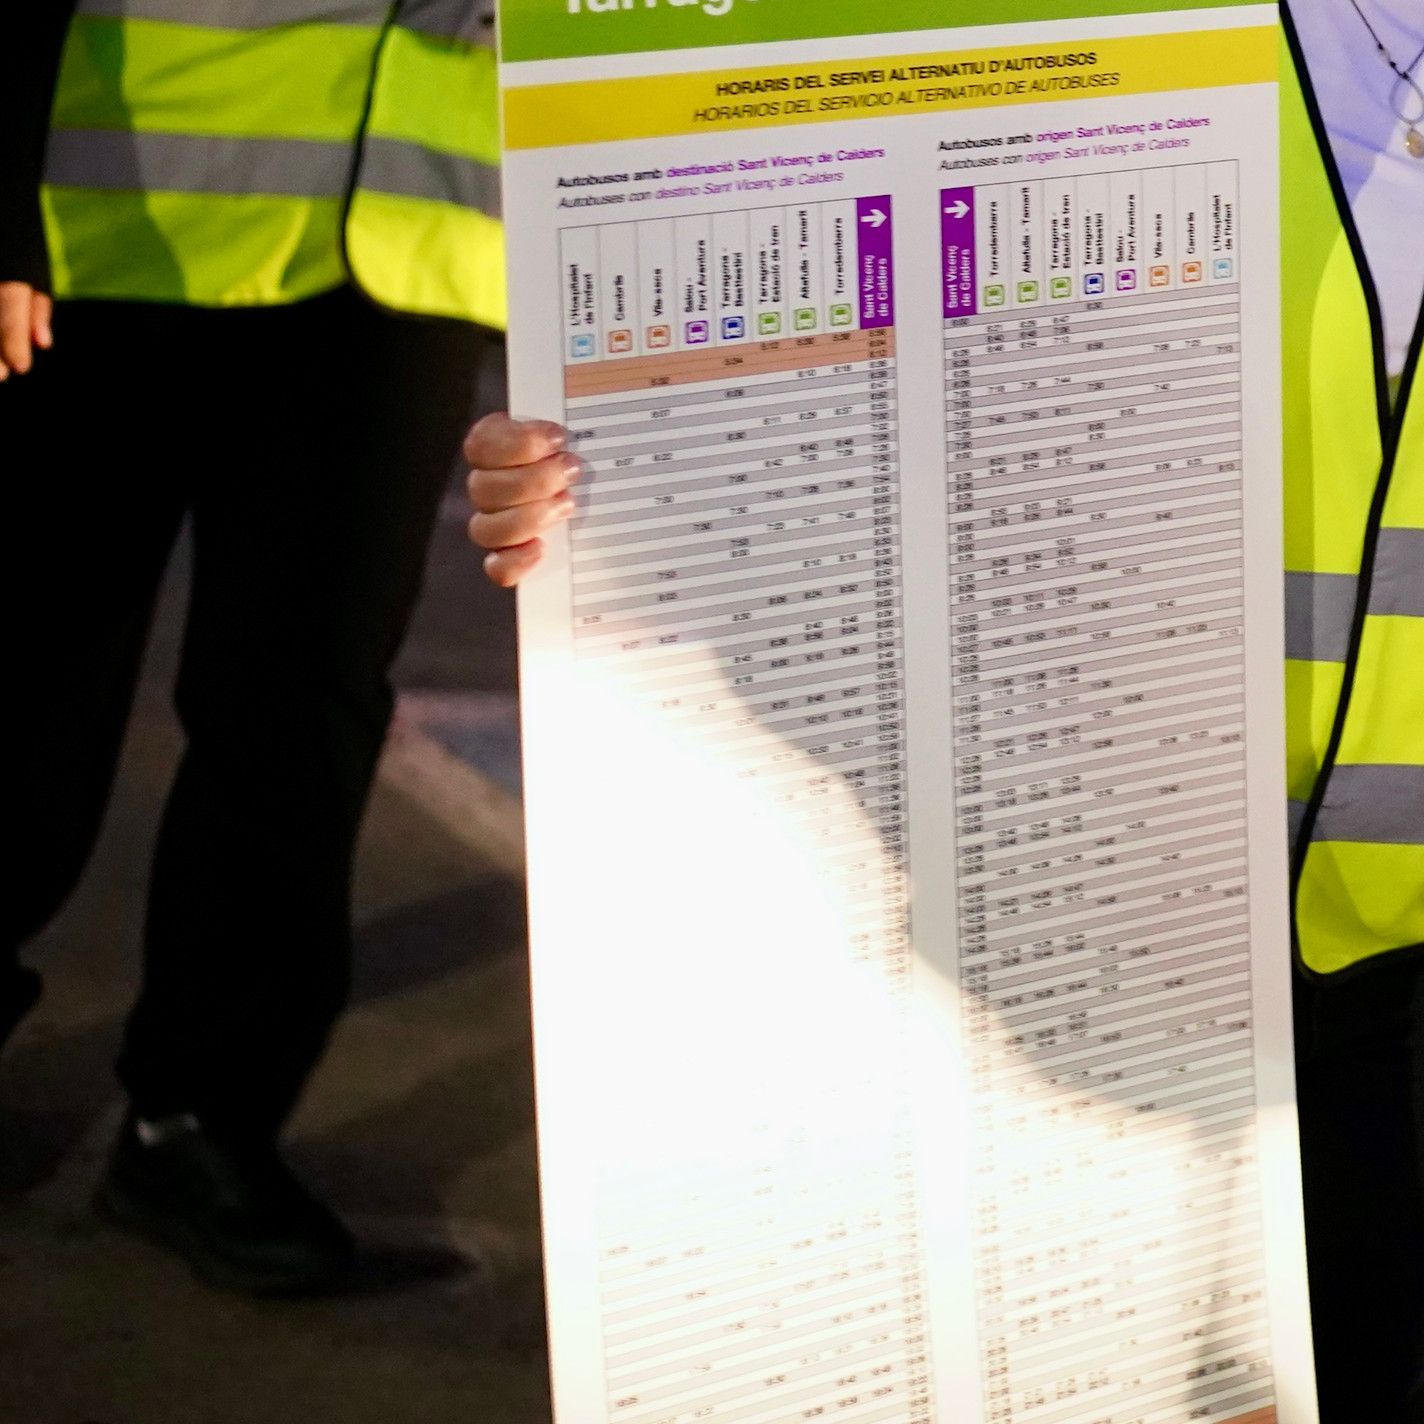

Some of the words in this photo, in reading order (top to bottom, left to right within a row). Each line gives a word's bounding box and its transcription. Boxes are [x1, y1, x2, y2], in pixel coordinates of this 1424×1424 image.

[716, 78, 790, 96] HORARIS
[794, 75, 825, 90] DEL
[829, 70, 886, 87] SERVEI
[889, 61, 985, 81] ALTERNATIU
[988, 52, 1098, 73] D'AUTOBUSOS
[693, 101, 781, 122] HORARIOS
[783, 99, 815, 114] DEL
[818, 92, 894, 111] SERVICIO
[897, 82, 1003, 104] ALTERNATIVO
[1004, 80, 1027, 95] DE
[1031, 72, 1122, 92] AUTOBUSES
[938, 137, 1003, 151] Autobusos
[1006, 134, 1033, 143] amb
[1036, 129, 1074, 143] origen
[1077, 127, 1105, 137] Sant
[1106, 124, 1147, 135] Vicenç
[1149, 122, 1164, 131] de
[1166, 118, 1212, 129] Calders
[939, 156, 1000, 170] Autobuses
[1002, 154, 1024, 164] con
[1026, 150, 1062, 164] origen
[1064, 148, 1090, 158] Sant
[1132, 141, 1147, 151] de
[1149, 137, 1191, 150] Calders
[557, 172, 630, 187] Autobusos
[634, 169, 664, 180] amb
[666, 162, 734, 177] destinació
[737, 160, 768, 171] Sant
[771, 155, 814, 167] Vicenç
[817, 152, 833, 163] de
[836, 148, 886, 161] Calders
[557, 191, 626, 208] Autobuses
[628, 191, 652, 202] con
[655, 185, 700, 199] destino
[703, 180, 733, 193] Sant
[779, 175, 796, 187] de
[798, 171, 845, 185] Calders
